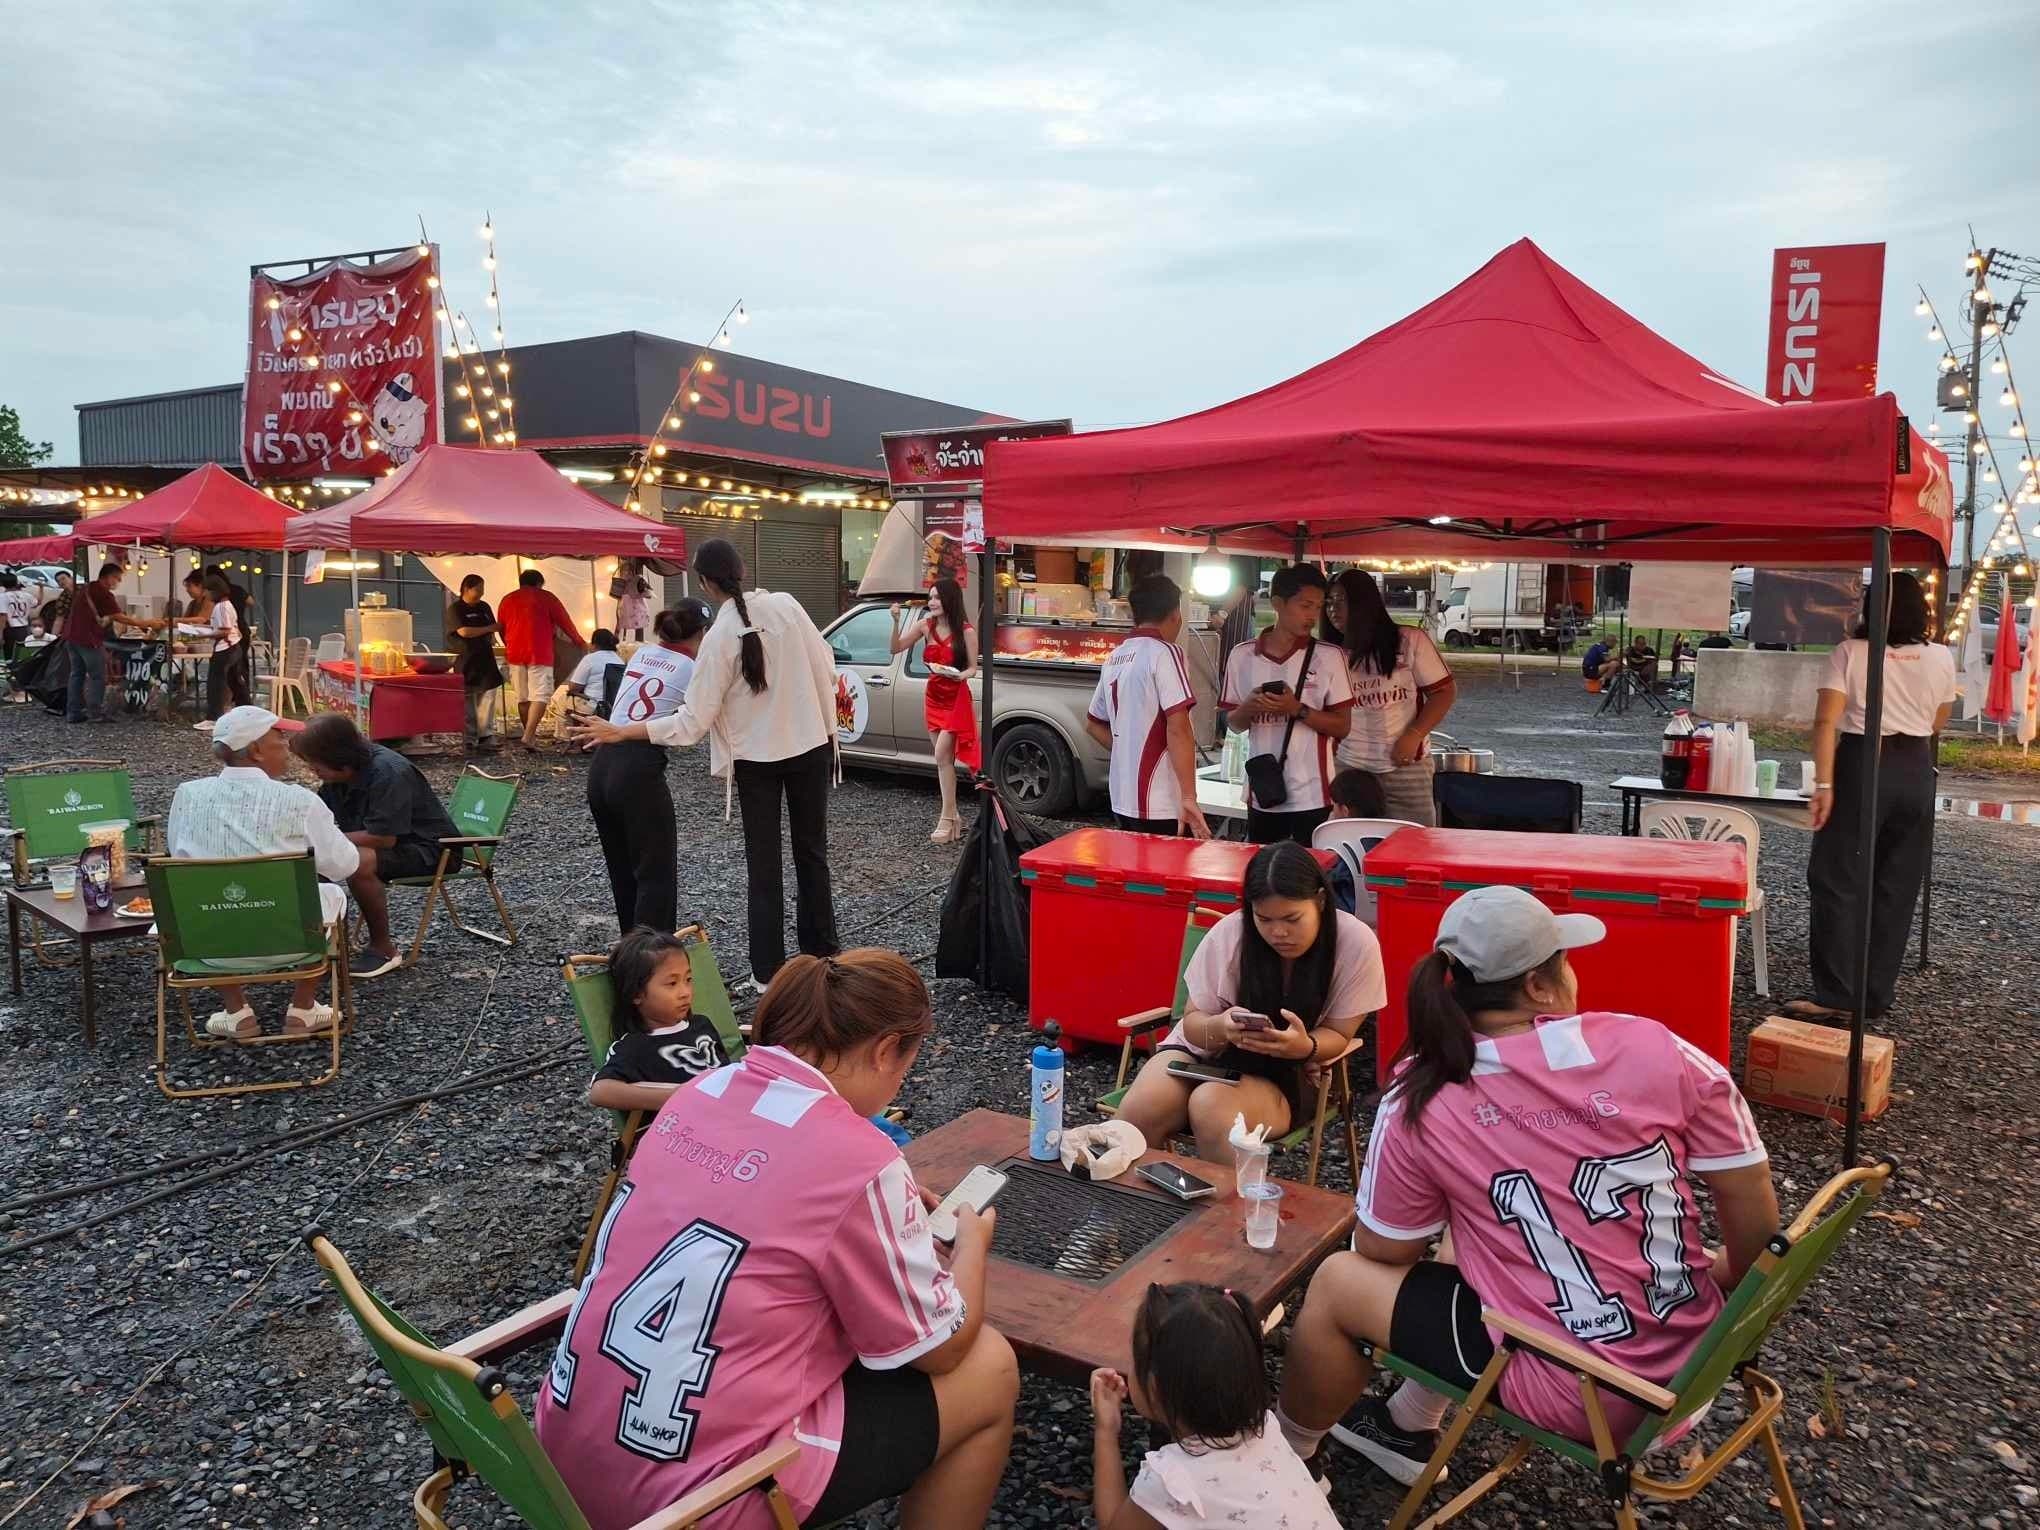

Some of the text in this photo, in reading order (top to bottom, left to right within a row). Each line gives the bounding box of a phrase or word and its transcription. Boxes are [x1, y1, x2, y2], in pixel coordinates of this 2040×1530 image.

[310, 292, 401, 330] ISUZU
[1782, 271, 1821, 405] ISUZ
[679, 366, 832, 438] ISUZU
[613, 670, 664, 722] 78
[1489, 1134, 1695, 1344] 17
[1594, 1311, 1618, 1328] SHOP
[650, 1425, 679, 1443] SHOP
